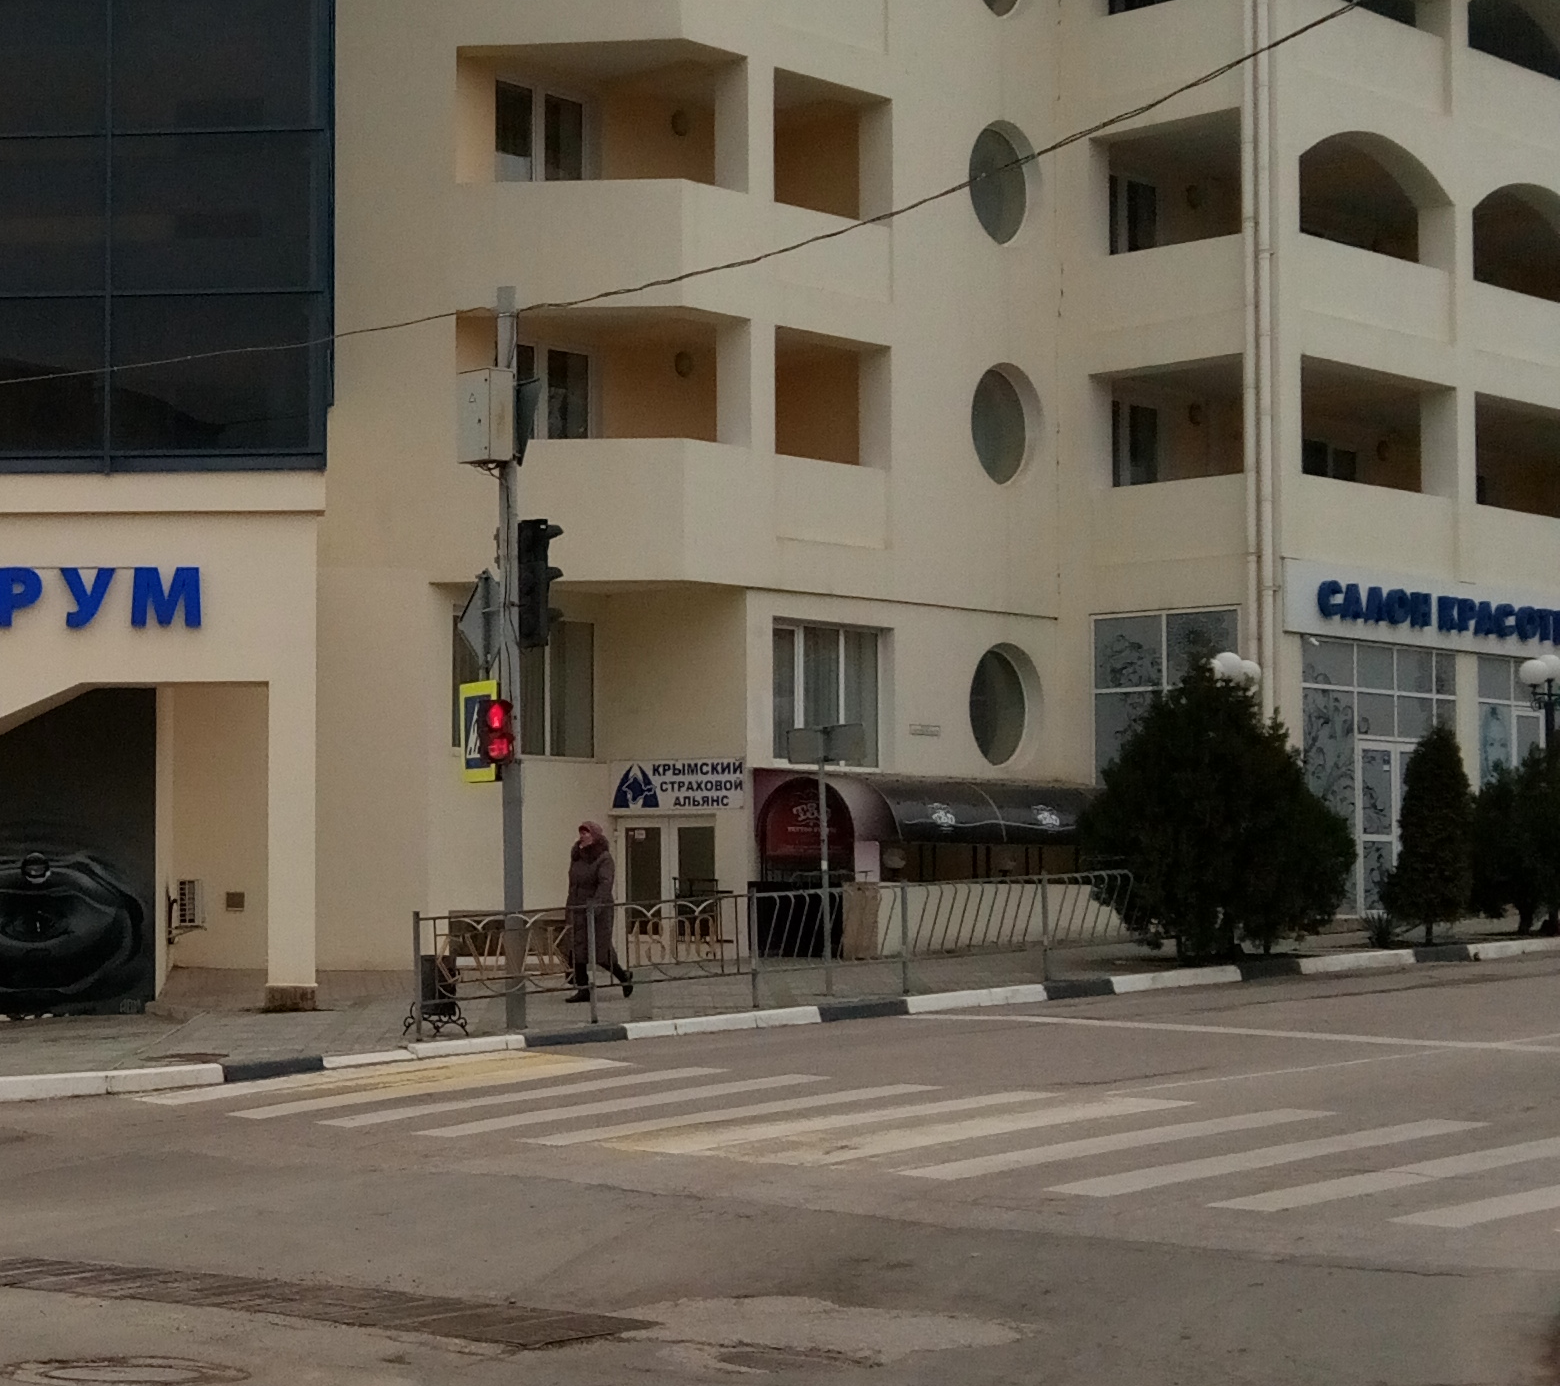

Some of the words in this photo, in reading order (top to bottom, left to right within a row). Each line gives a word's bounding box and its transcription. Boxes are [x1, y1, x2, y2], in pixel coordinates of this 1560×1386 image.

[1317, 579, 1433, 628] САЛОН
[652, 758, 743, 777] КРЫМСКИЙ
[660, 777, 743, 793] СТРАХОВОЙ
[673, 795, 730, 807] АЛЬЯНС
